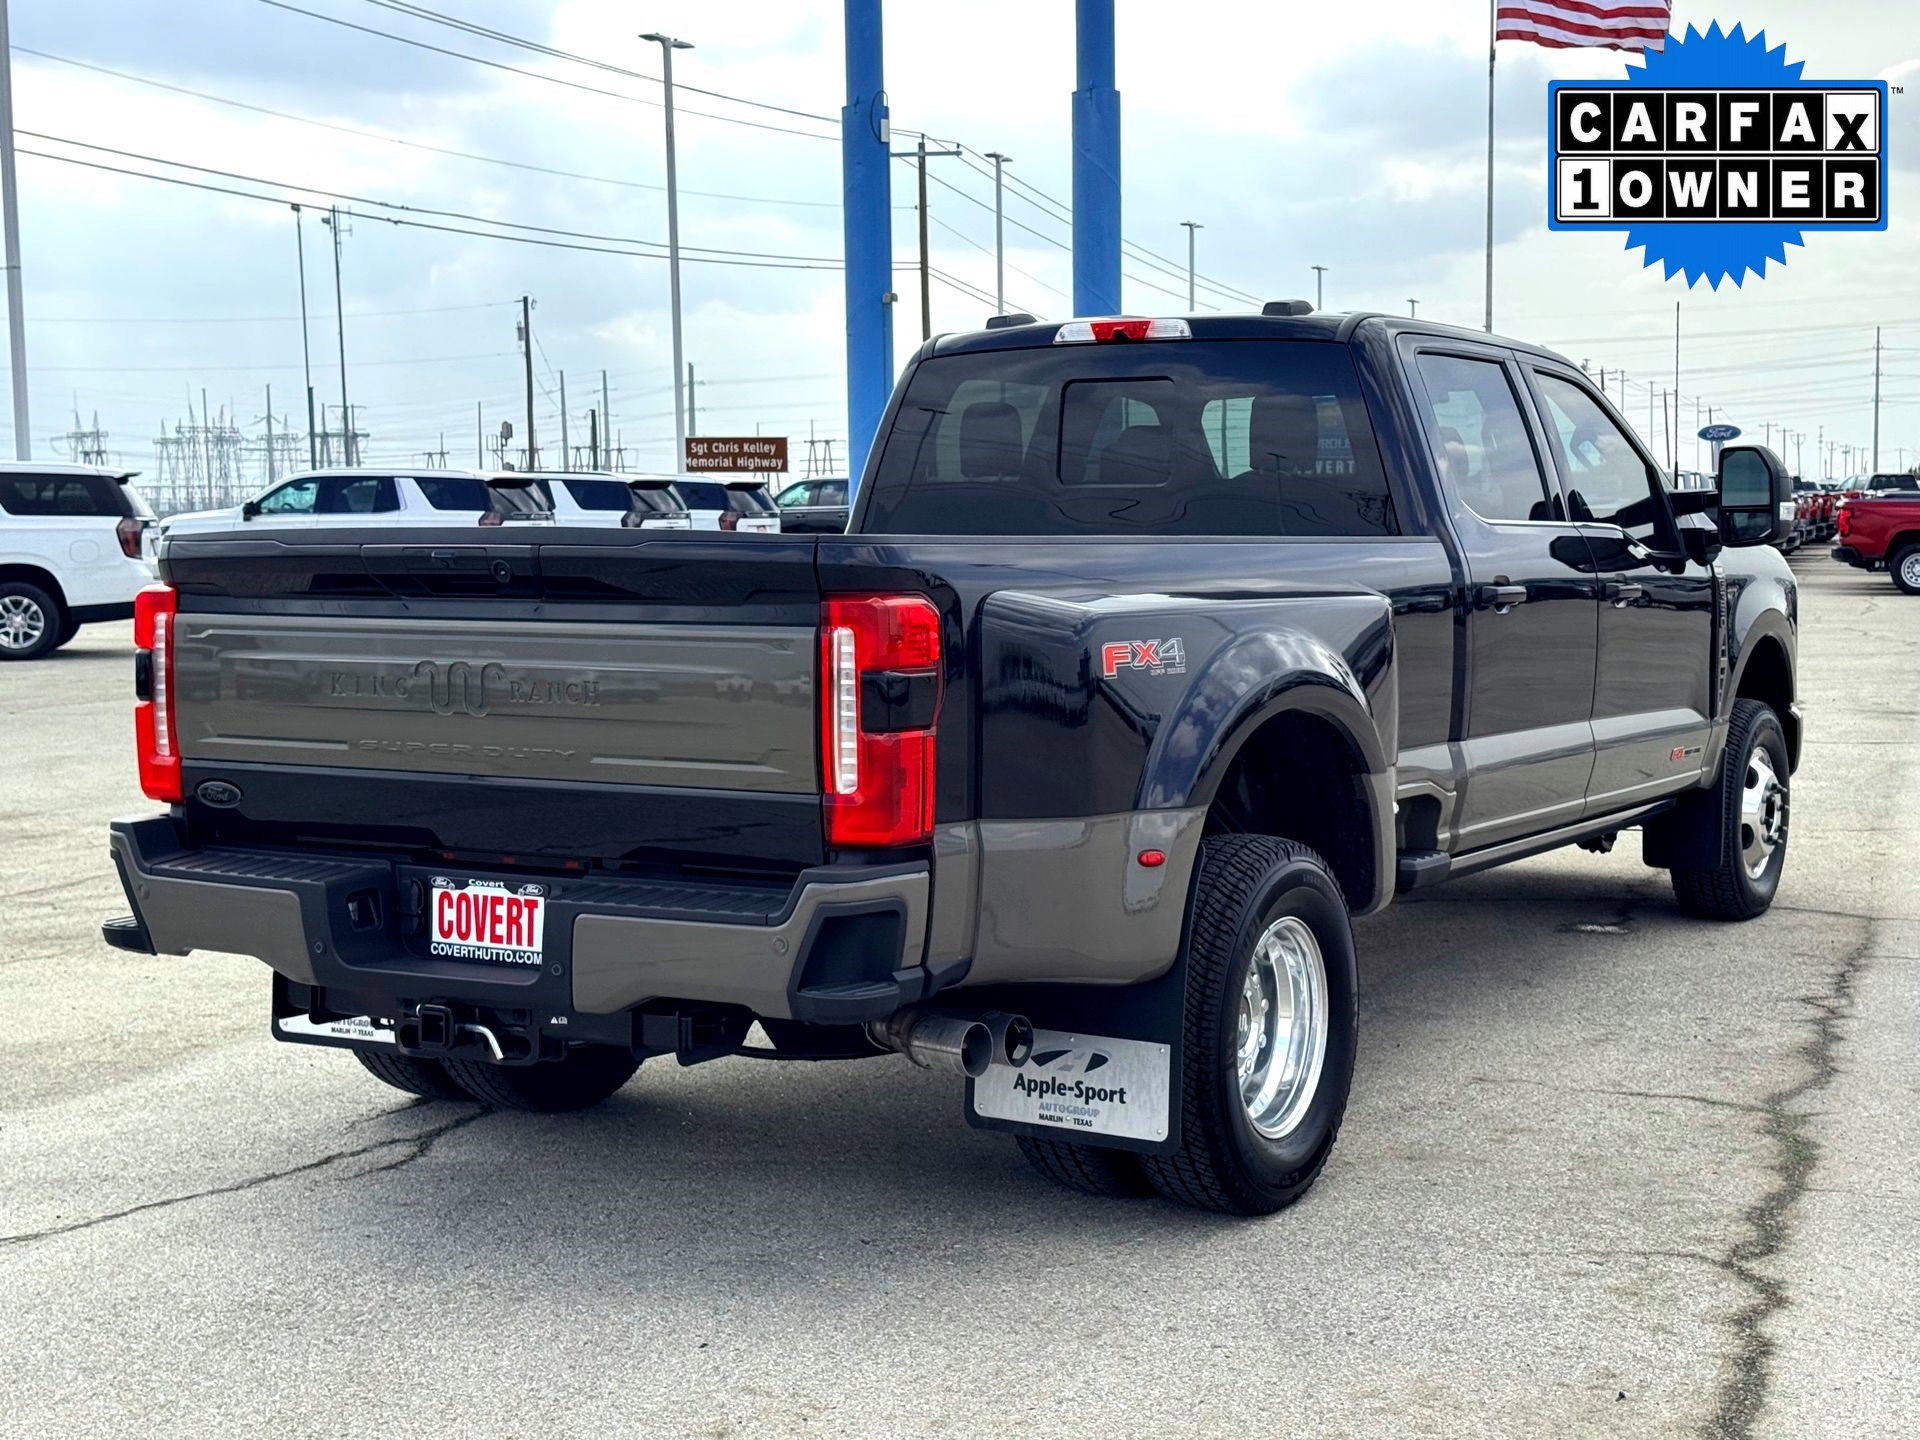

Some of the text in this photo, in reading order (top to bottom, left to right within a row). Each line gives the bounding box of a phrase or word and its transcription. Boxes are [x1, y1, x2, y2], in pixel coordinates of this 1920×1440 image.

[691, 442, 776, 455] Sgt Chris Kelley
[686, 457, 783, 469] Memorial Highway
[1297, 460, 1355, 475] VERT
[1102, 637, 1186, 680] FX4
[331, 671, 600, 706] KING RANCH
[359, 739, 577, 761] SUPER DUTY
[468, 879, 505, 888] Covert
[438, 890, 539, 948] COVERT
[430, 942, 543, 965] COVERTHUTTO.COM
[1013, 1072, 1127, 1105] Apple-Sport
[1038, 1102, 1100, 1118] AUTOGROUP
[1038, 1113, 1093, 1127] MARLIN TEXAS
